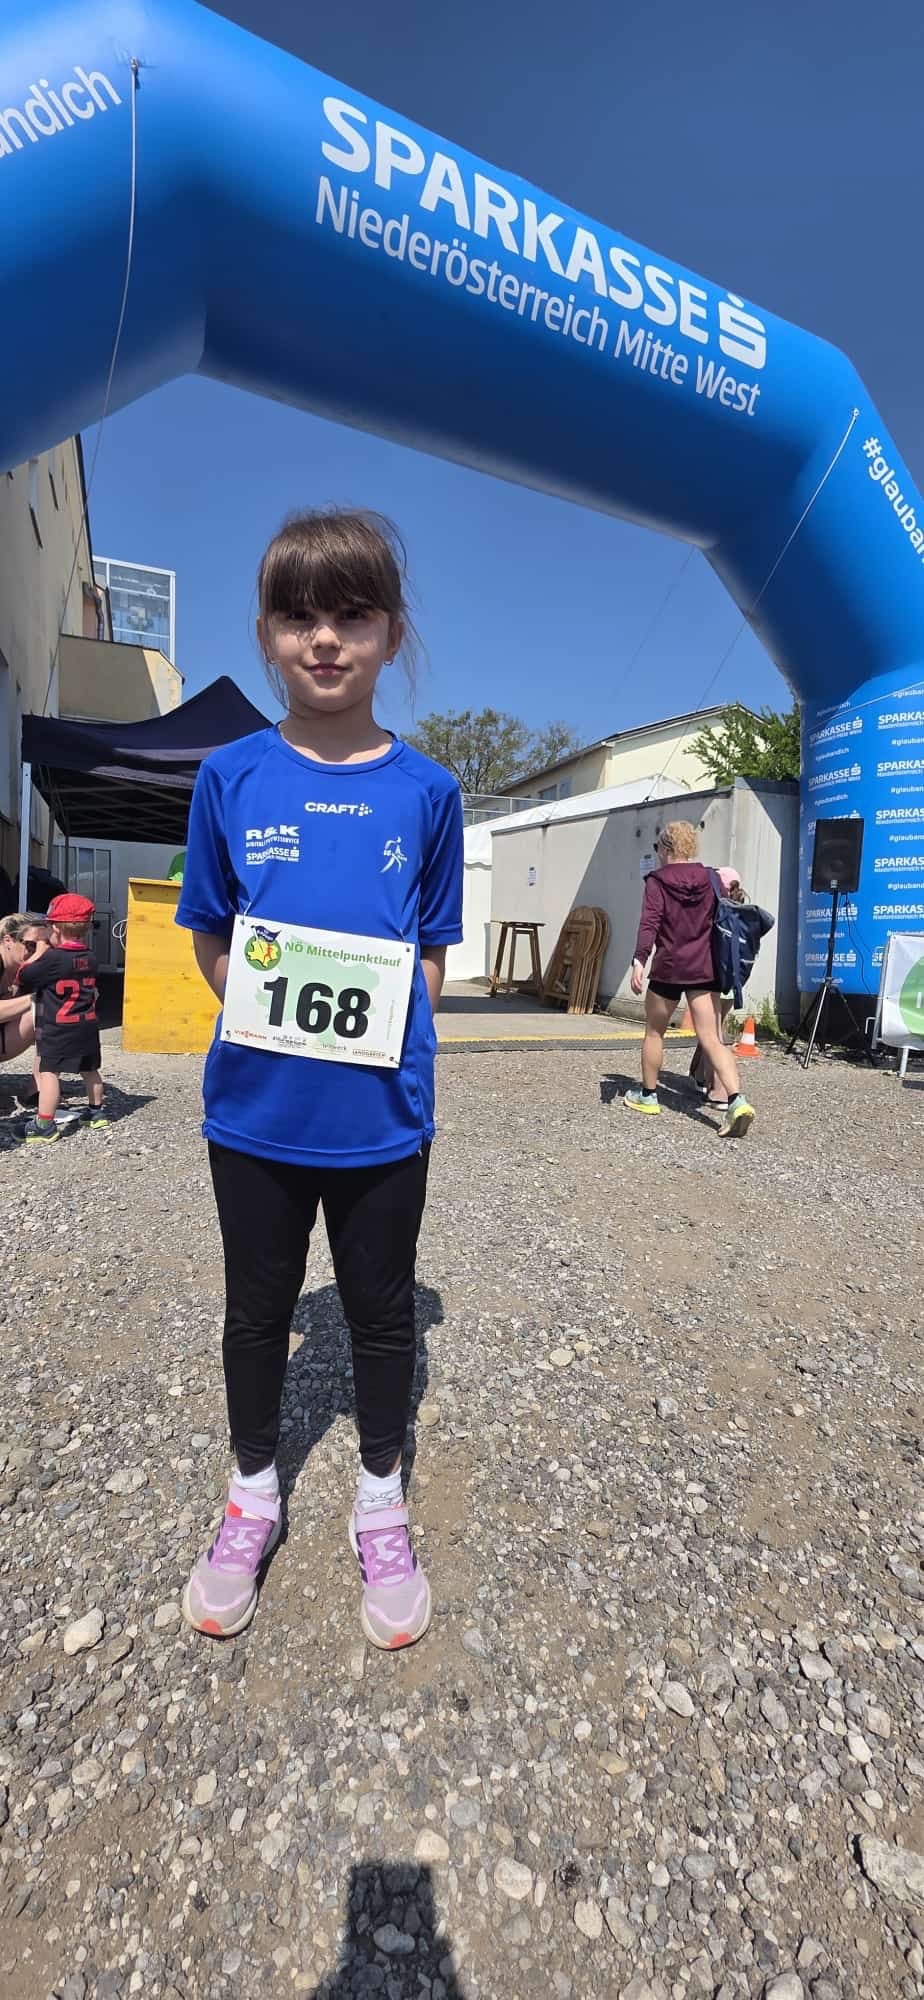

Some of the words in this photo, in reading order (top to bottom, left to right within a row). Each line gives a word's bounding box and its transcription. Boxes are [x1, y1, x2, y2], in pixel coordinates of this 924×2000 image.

[321, 96, 709, 345] SPARKASSE
[315, 175, 609, 352] Niederösterreich
[614, 320, 689, 385] Mitte
[695, 355, 761, 417] West
[808, 768, 849, 786] SPARKASSE
[304, 801, 358, 815] CRAFT
[284, 940, 304, 953] NÖ
[305, 944, 402, 967] Mittelpunktlauf
[263, 976, 371, 1039] 168
